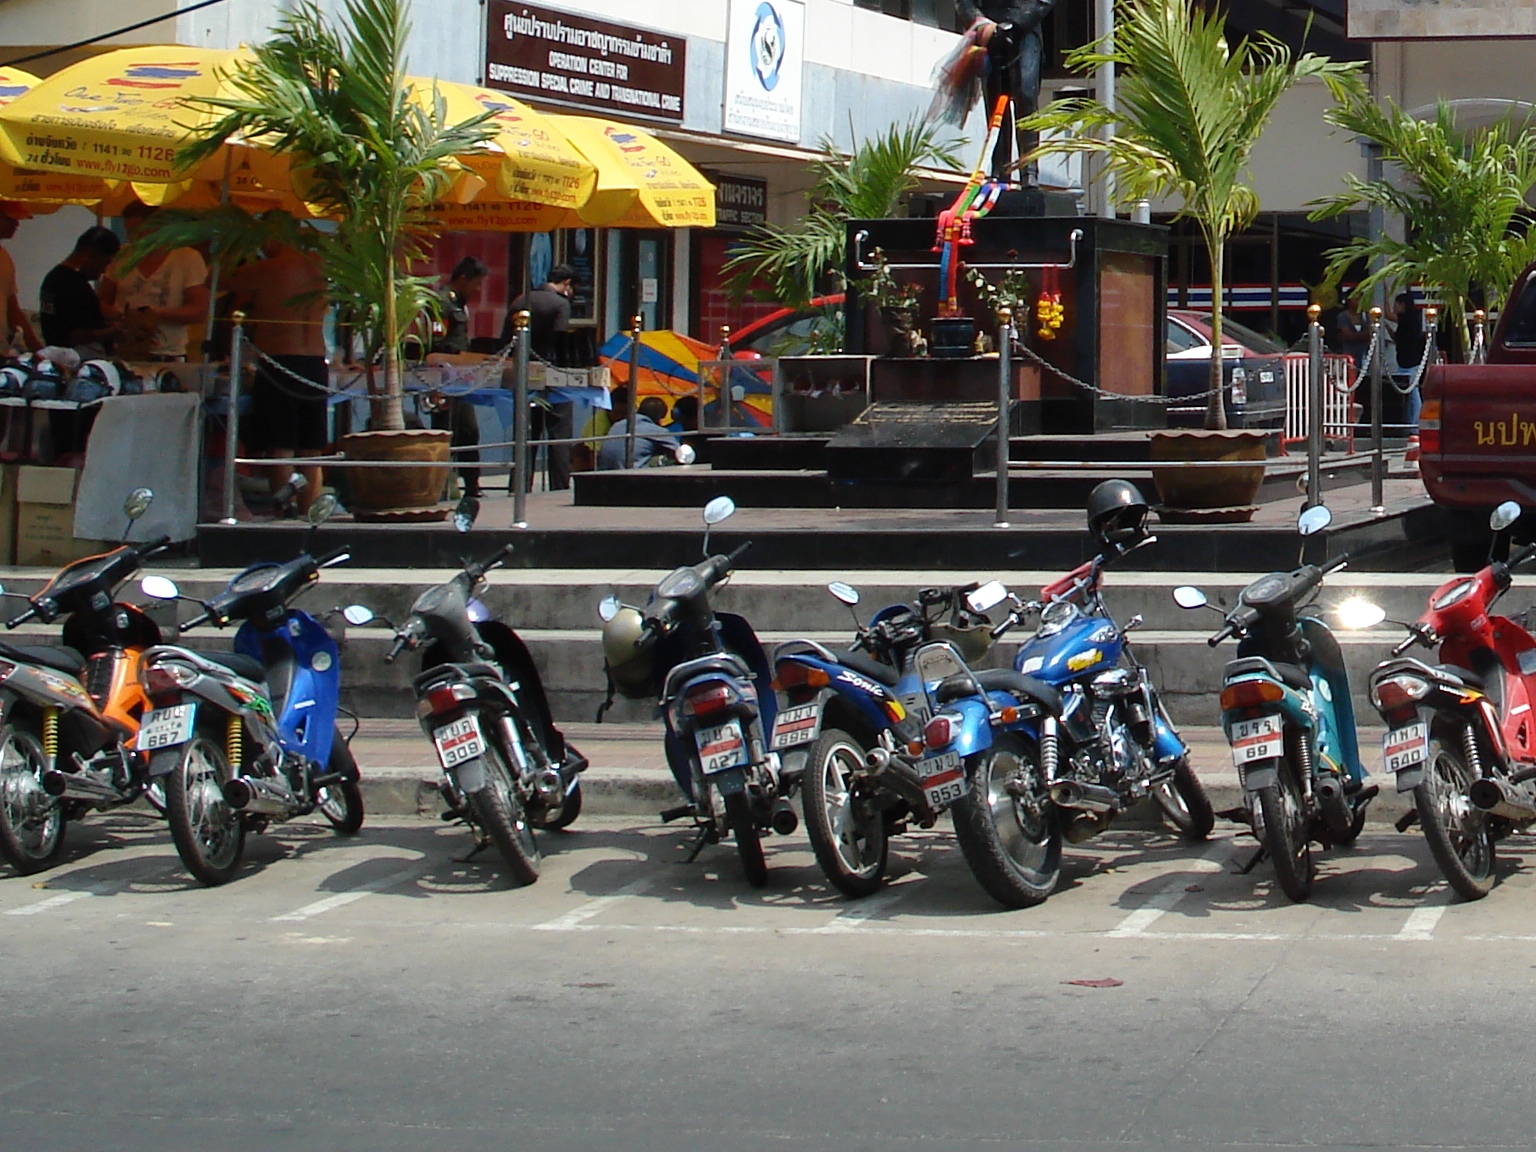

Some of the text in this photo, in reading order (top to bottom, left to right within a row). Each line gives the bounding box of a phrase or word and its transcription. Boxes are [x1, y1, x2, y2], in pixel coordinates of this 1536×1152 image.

[548, 50, 629, 81] OPERATION CENTER FOR
[489, 62, 682, 113] SUPPRESSION SPECIAL CRIME AND TRANSNATIONAL CRIME
[138, 145, 175, 162] 1126
[836, 670, 886, 698] Sonic
[446, 742, 479, 763] 309
[709, 752, 739, 770] 427
[1246, 745, 1268, 759] 69
[1390, 749, 1421, 770] 640
[931, 784, 962, 804] 853
